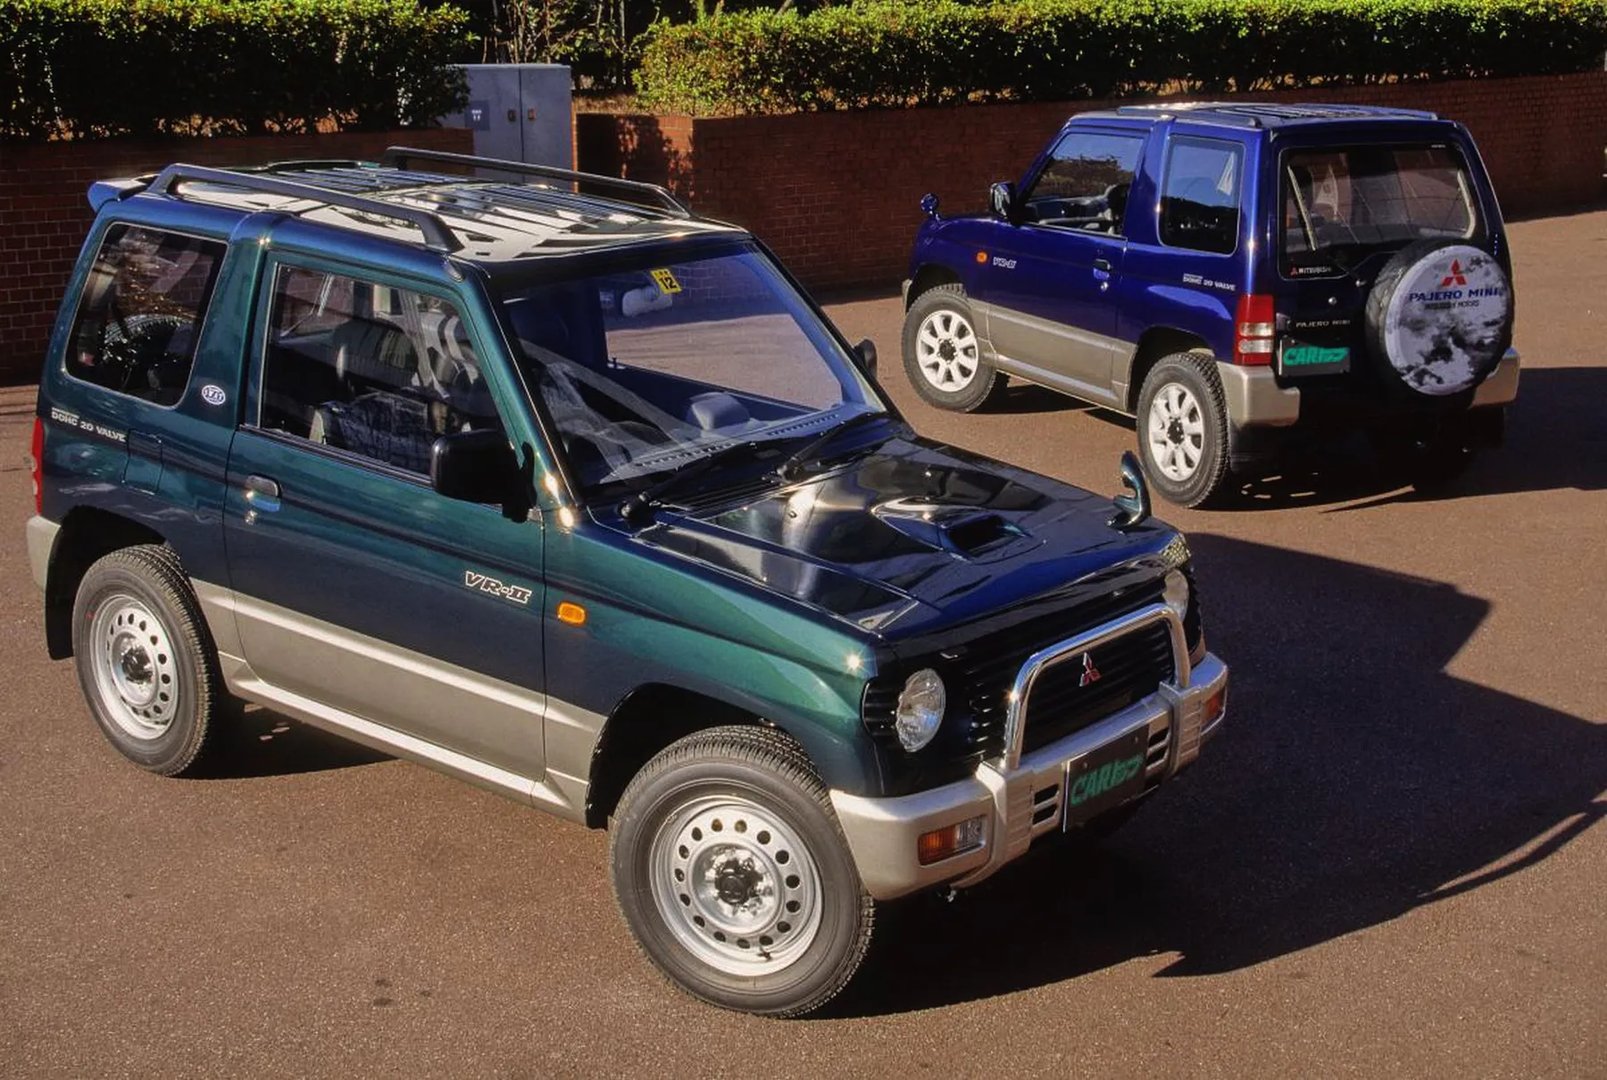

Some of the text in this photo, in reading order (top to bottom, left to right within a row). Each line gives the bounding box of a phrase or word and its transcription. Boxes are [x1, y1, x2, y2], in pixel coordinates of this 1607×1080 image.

[659, 276, 677, 289] 12
[1214, 281, 1236, 291] VALVE
[1408, 287, 1499, 302] PAJERO MINI
[51, 411, 127, 443] DOHC 20 VALVE
